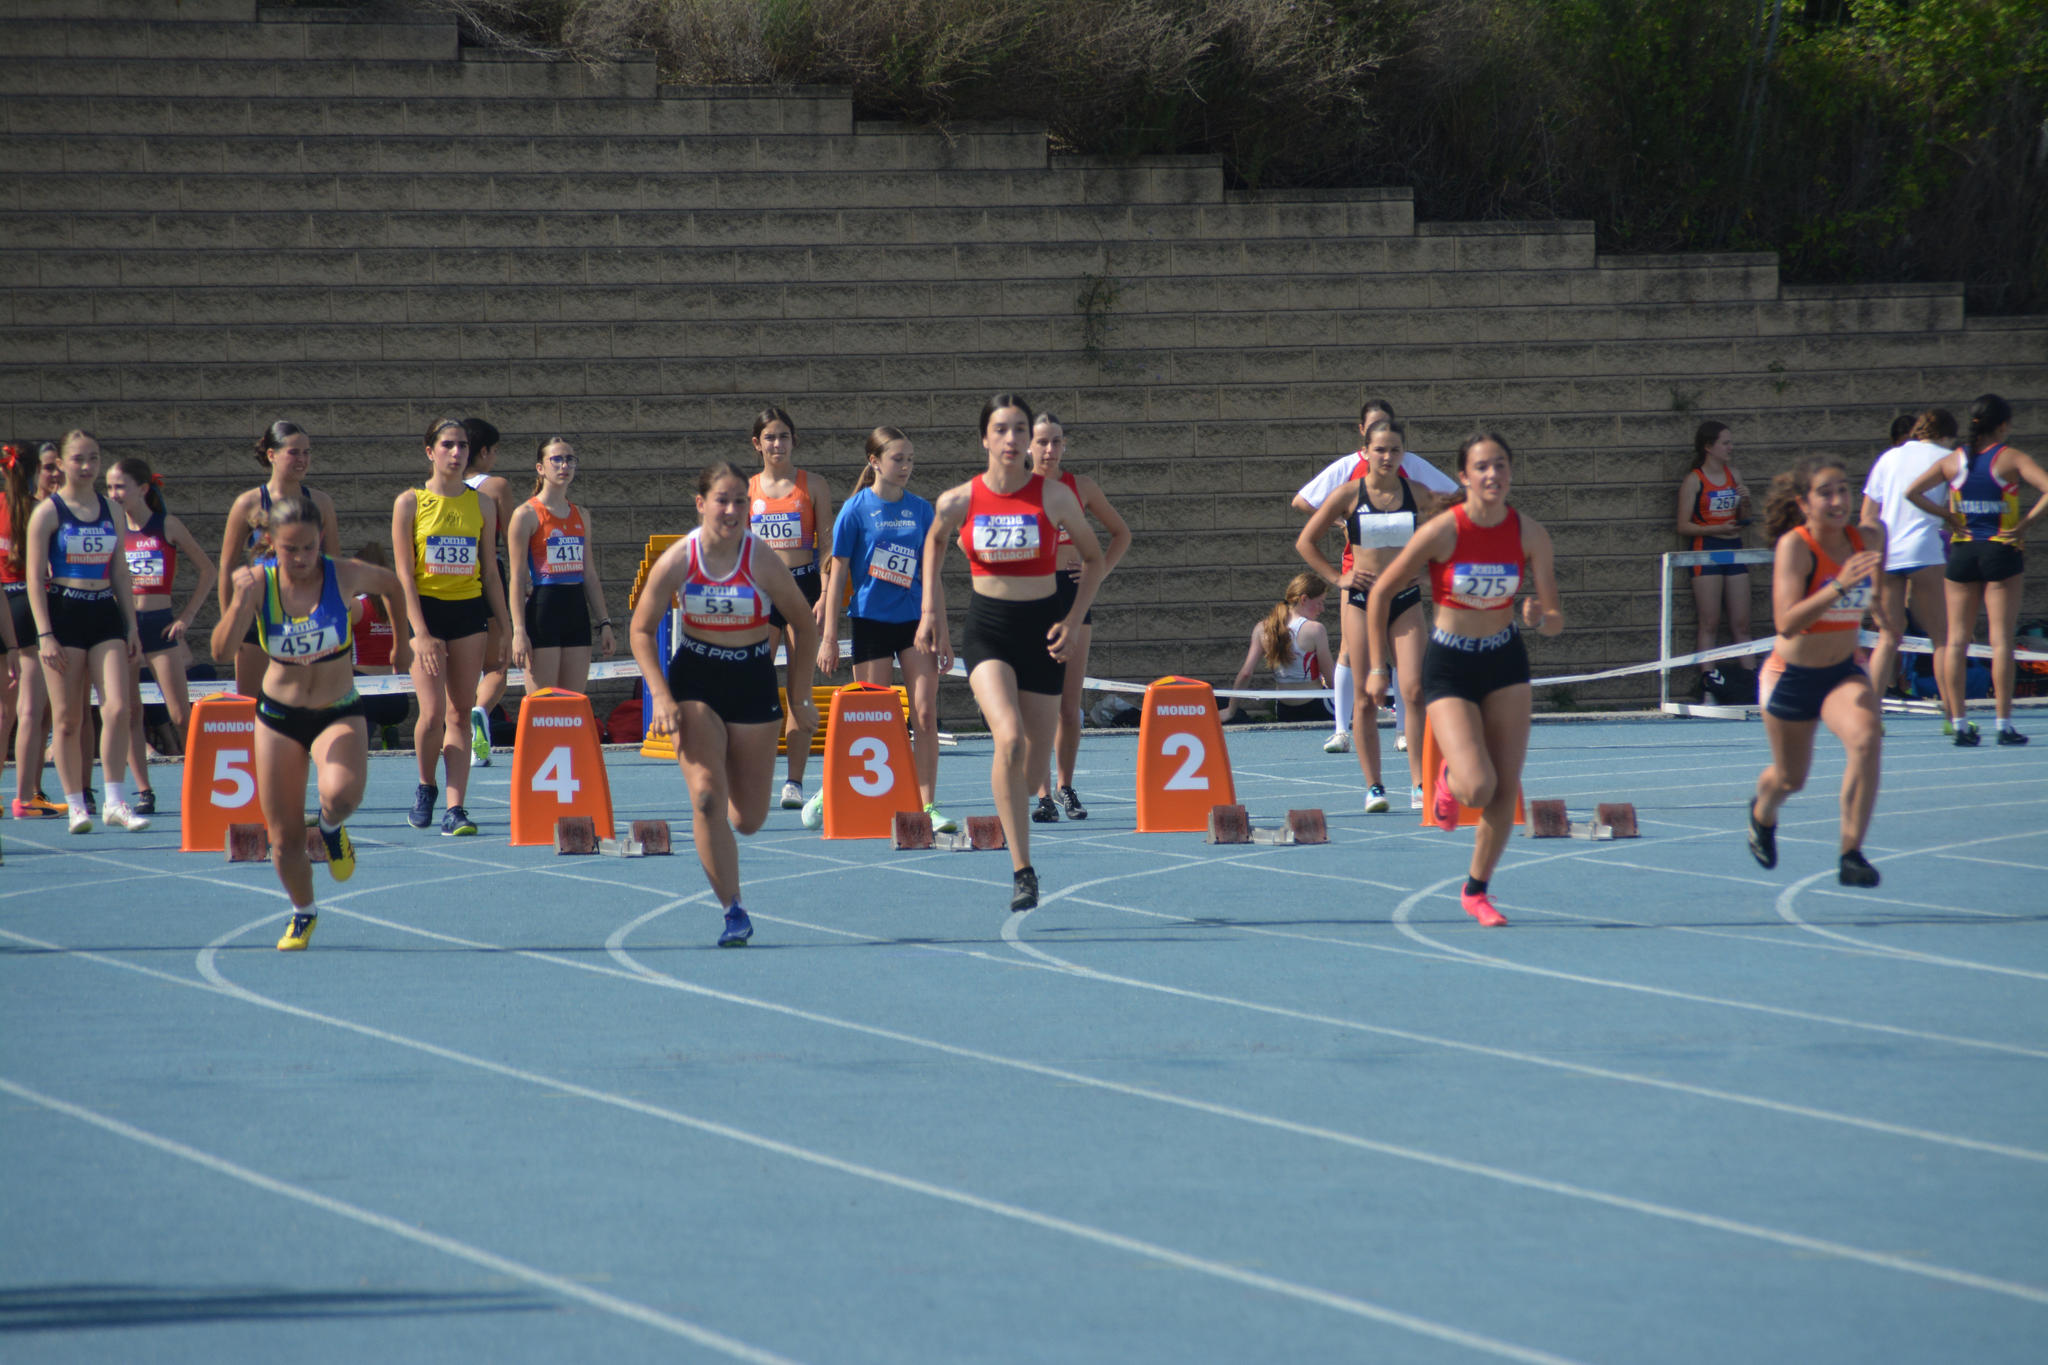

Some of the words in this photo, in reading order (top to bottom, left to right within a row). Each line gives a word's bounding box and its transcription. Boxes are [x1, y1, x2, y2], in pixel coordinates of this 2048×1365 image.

[760, 522, 792, 538] 406
[985, 528, 1027, 548] 273
[82, 537, 104, 553] 65
[434, 547, 469, 563] 438
[556, 546, 582, 561] 411
[887, 555, 909, 574] 61
[62, 588, 97, 600] NIKE
[1466, 577, 1506, 597] 275
[705, 598, 734, 615] 53
[280, 631, 325, 656] 457
[1433, 628, 1476, 652] NIKE
[1479, 628, 1511, 653] PRO
[707, 647, 748, 661] PRO
[843, 711, 893, 722] MONDO
[1157, 705, 1206, 716] MONDO
[203, 721, 255, 733] MONDO
[532, 716, 582, 727] MONDO
[848, 737, 894, 797] 3
[1161, 733, 1209, 790] 2
[210, 749, 255, 809] 5
[531, 746, 580, 804] 4
